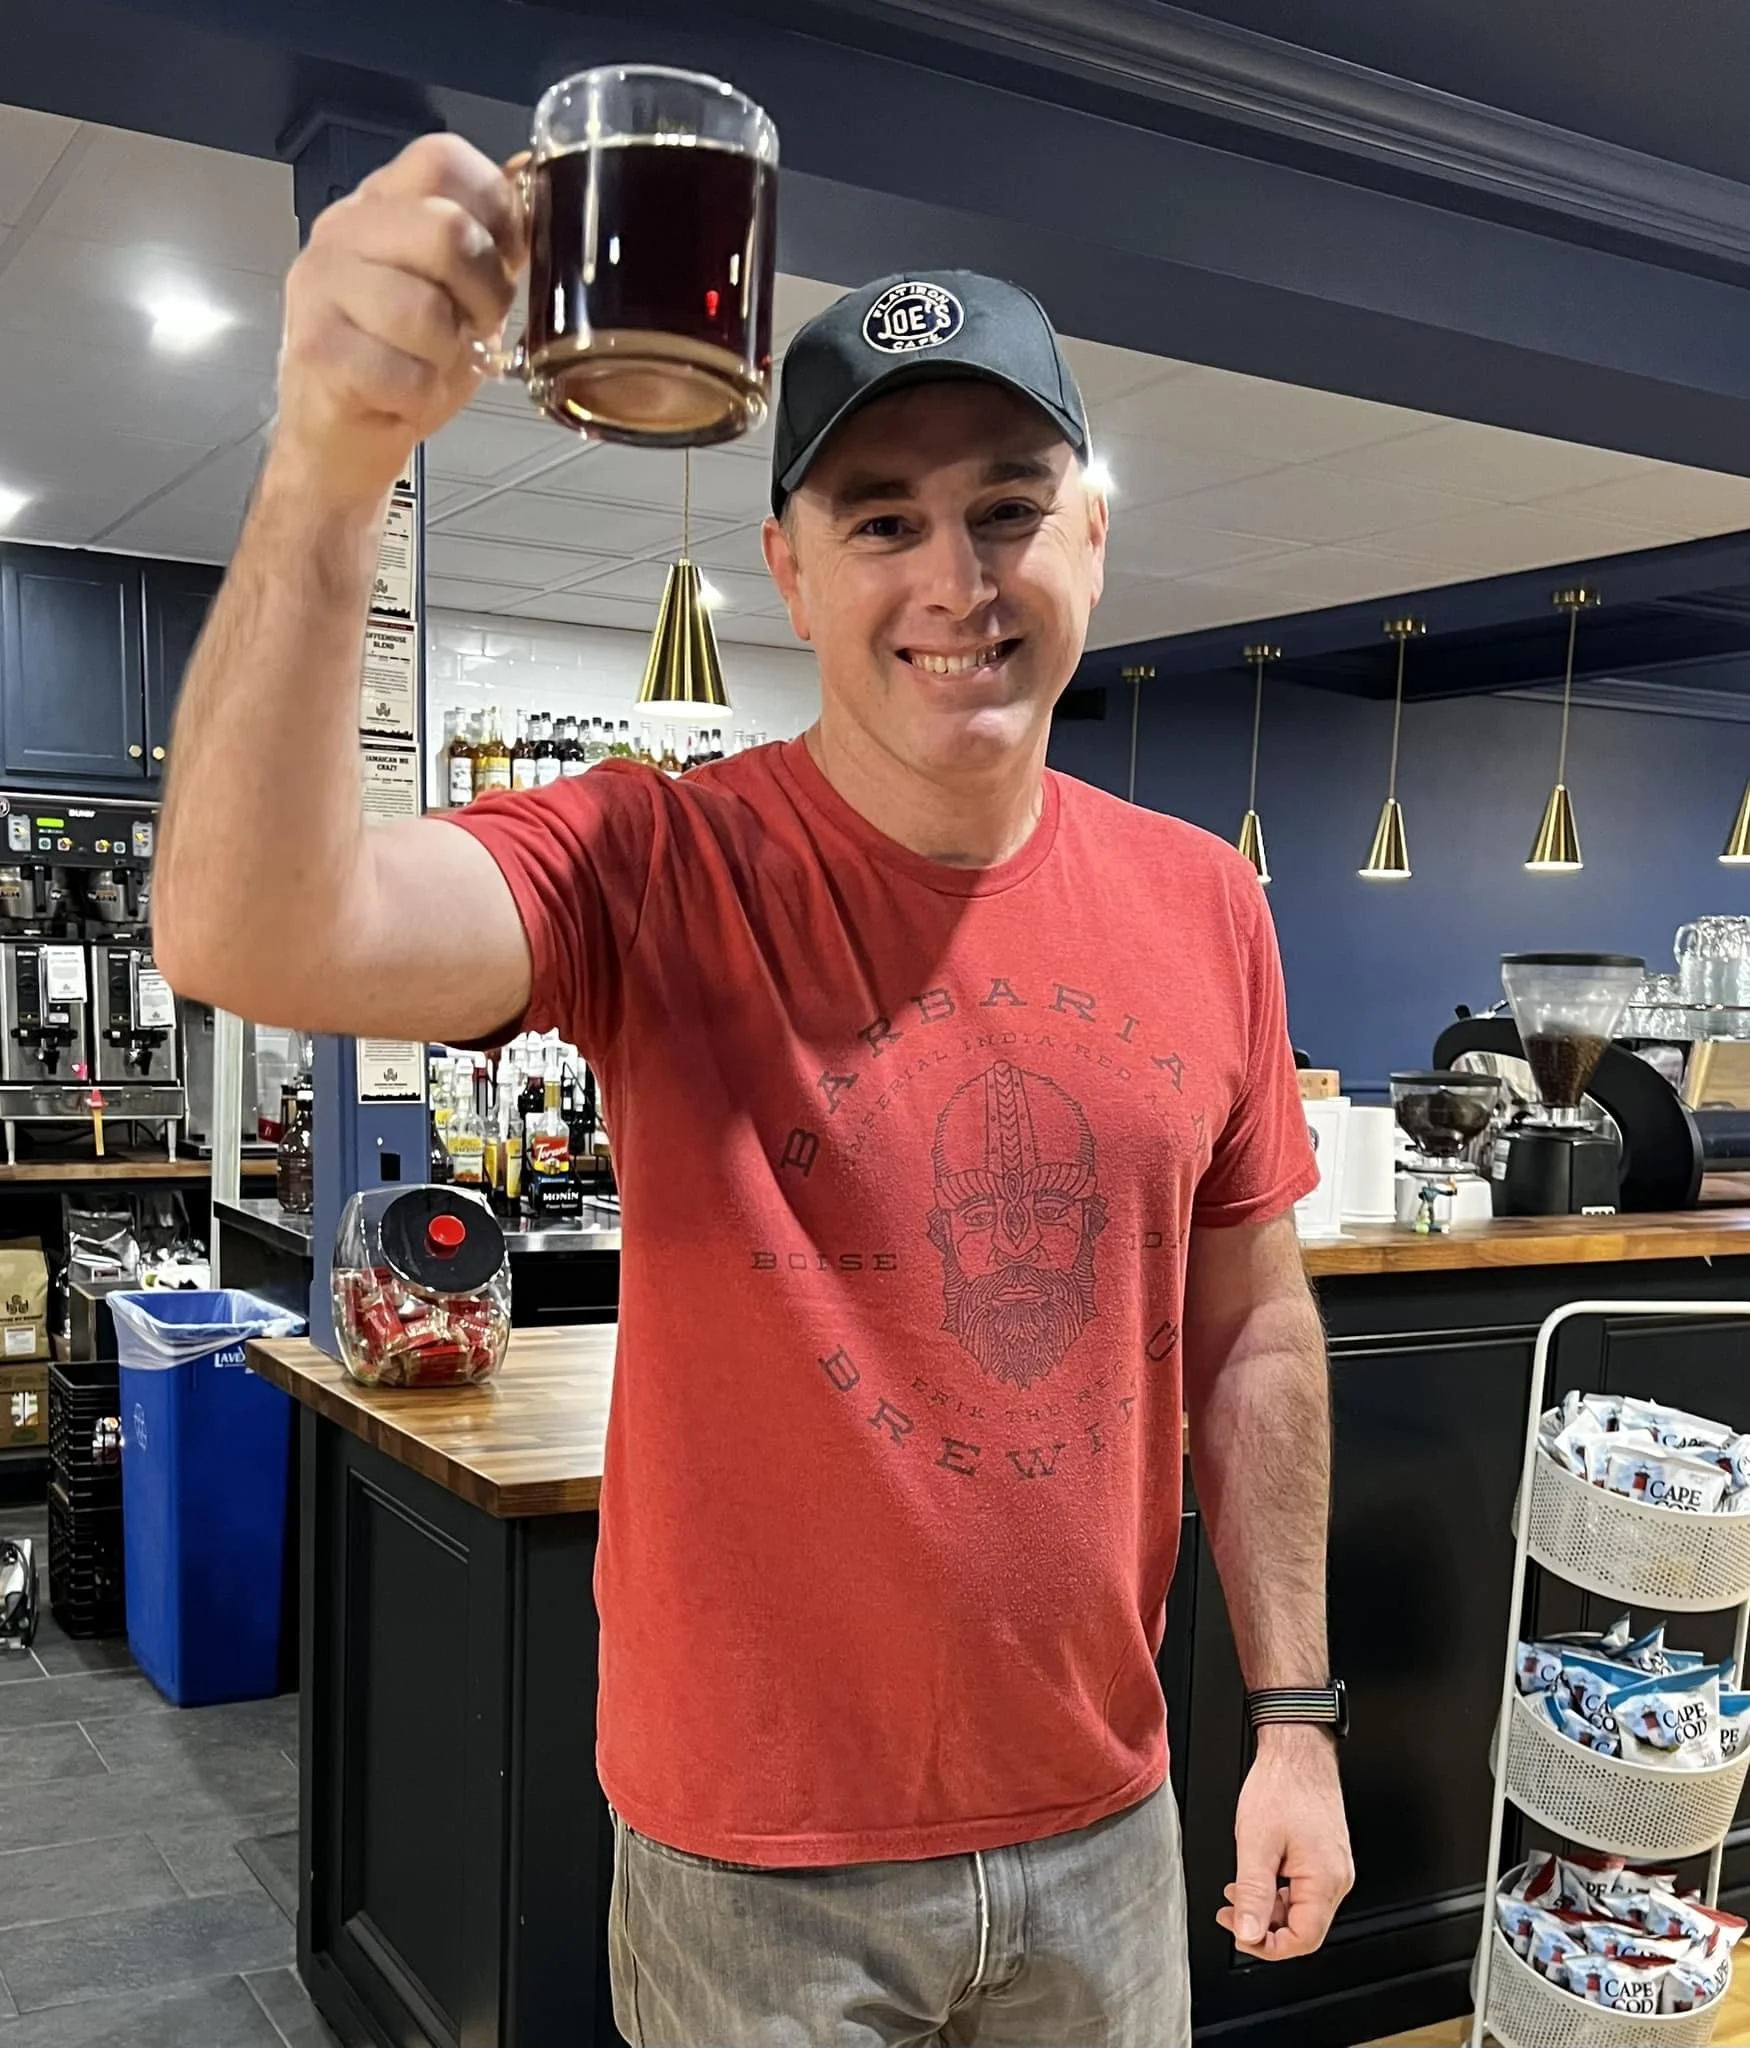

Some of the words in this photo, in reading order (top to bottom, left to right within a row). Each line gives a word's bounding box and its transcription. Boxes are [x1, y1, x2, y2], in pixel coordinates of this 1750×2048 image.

[877, 302, 951, 340] JOE'S
[373, 641, 395, 650] BLEND
[376, 763, 397, 771] CRAZY
[961, 1031, 1056, 1055] INDIA
[751, 1251, 898, 1272] BOISE
[1649, 1480, 1703, 1507] CAPE
[1662, 1701, 1708, 1729] CAPE
[1674, 1719, 1708, 1745] COD
[1720, 1728, 1740, 1745] PE
[1604, 1979, 1653, 1998] CAPE
